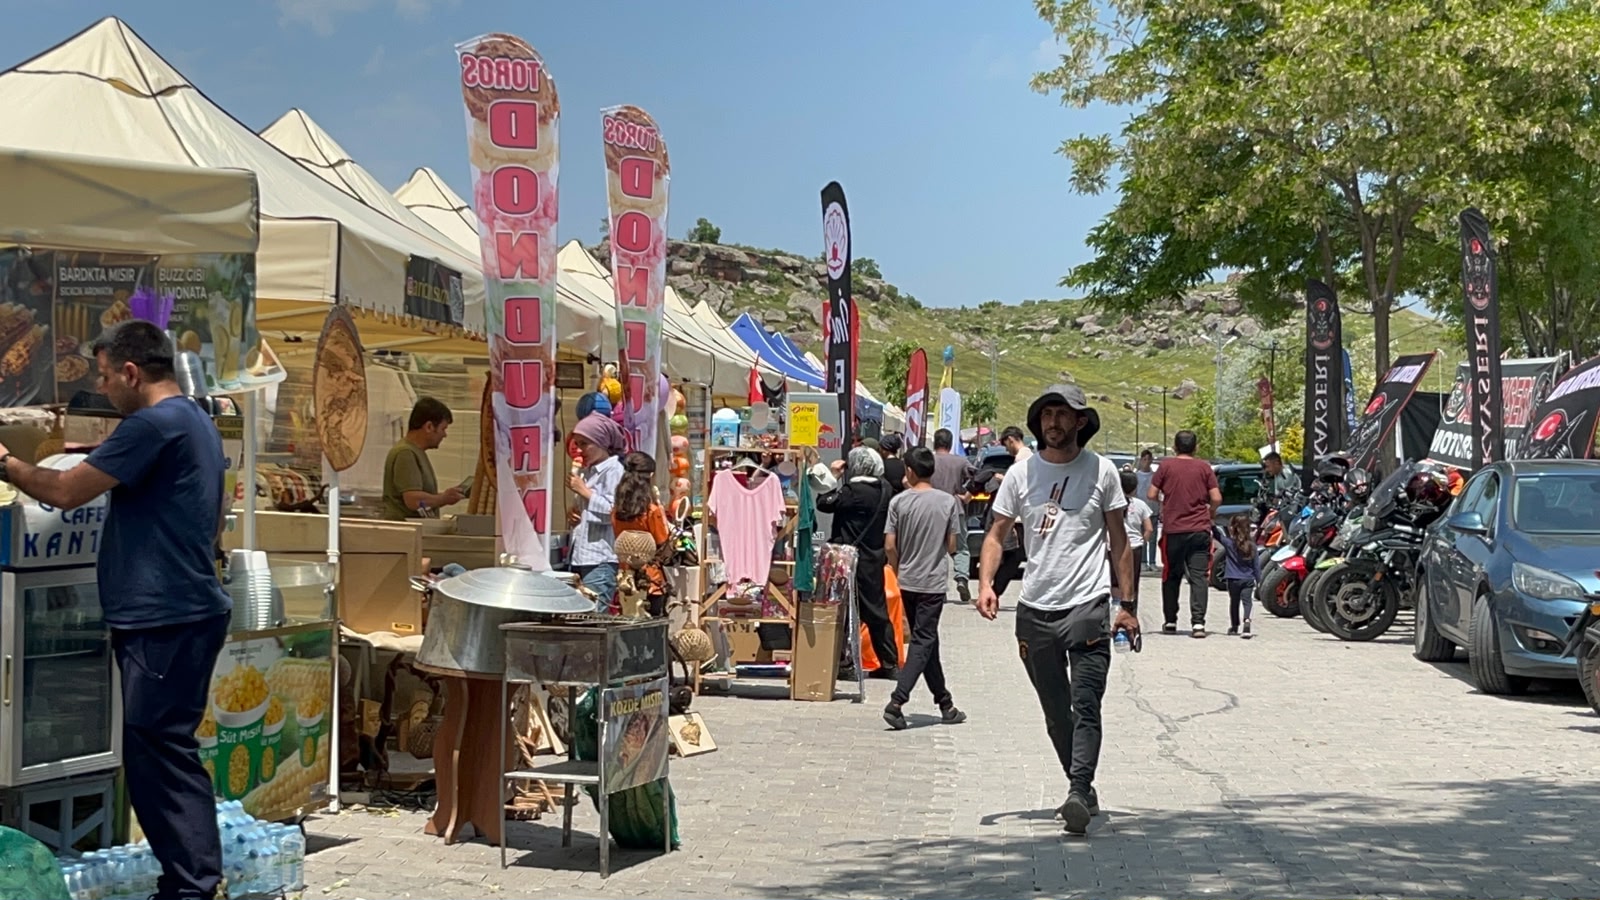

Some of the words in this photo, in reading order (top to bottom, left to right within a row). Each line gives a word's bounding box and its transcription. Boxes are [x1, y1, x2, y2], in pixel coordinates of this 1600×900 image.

[160, 268, 185, 282] BUZZ
[818, 437, 840, 448] Bull
[61, 506, 105, 525] CAFE
[23, 530, 99, 559] KANT
[219, 729, 237, 743] Süt
